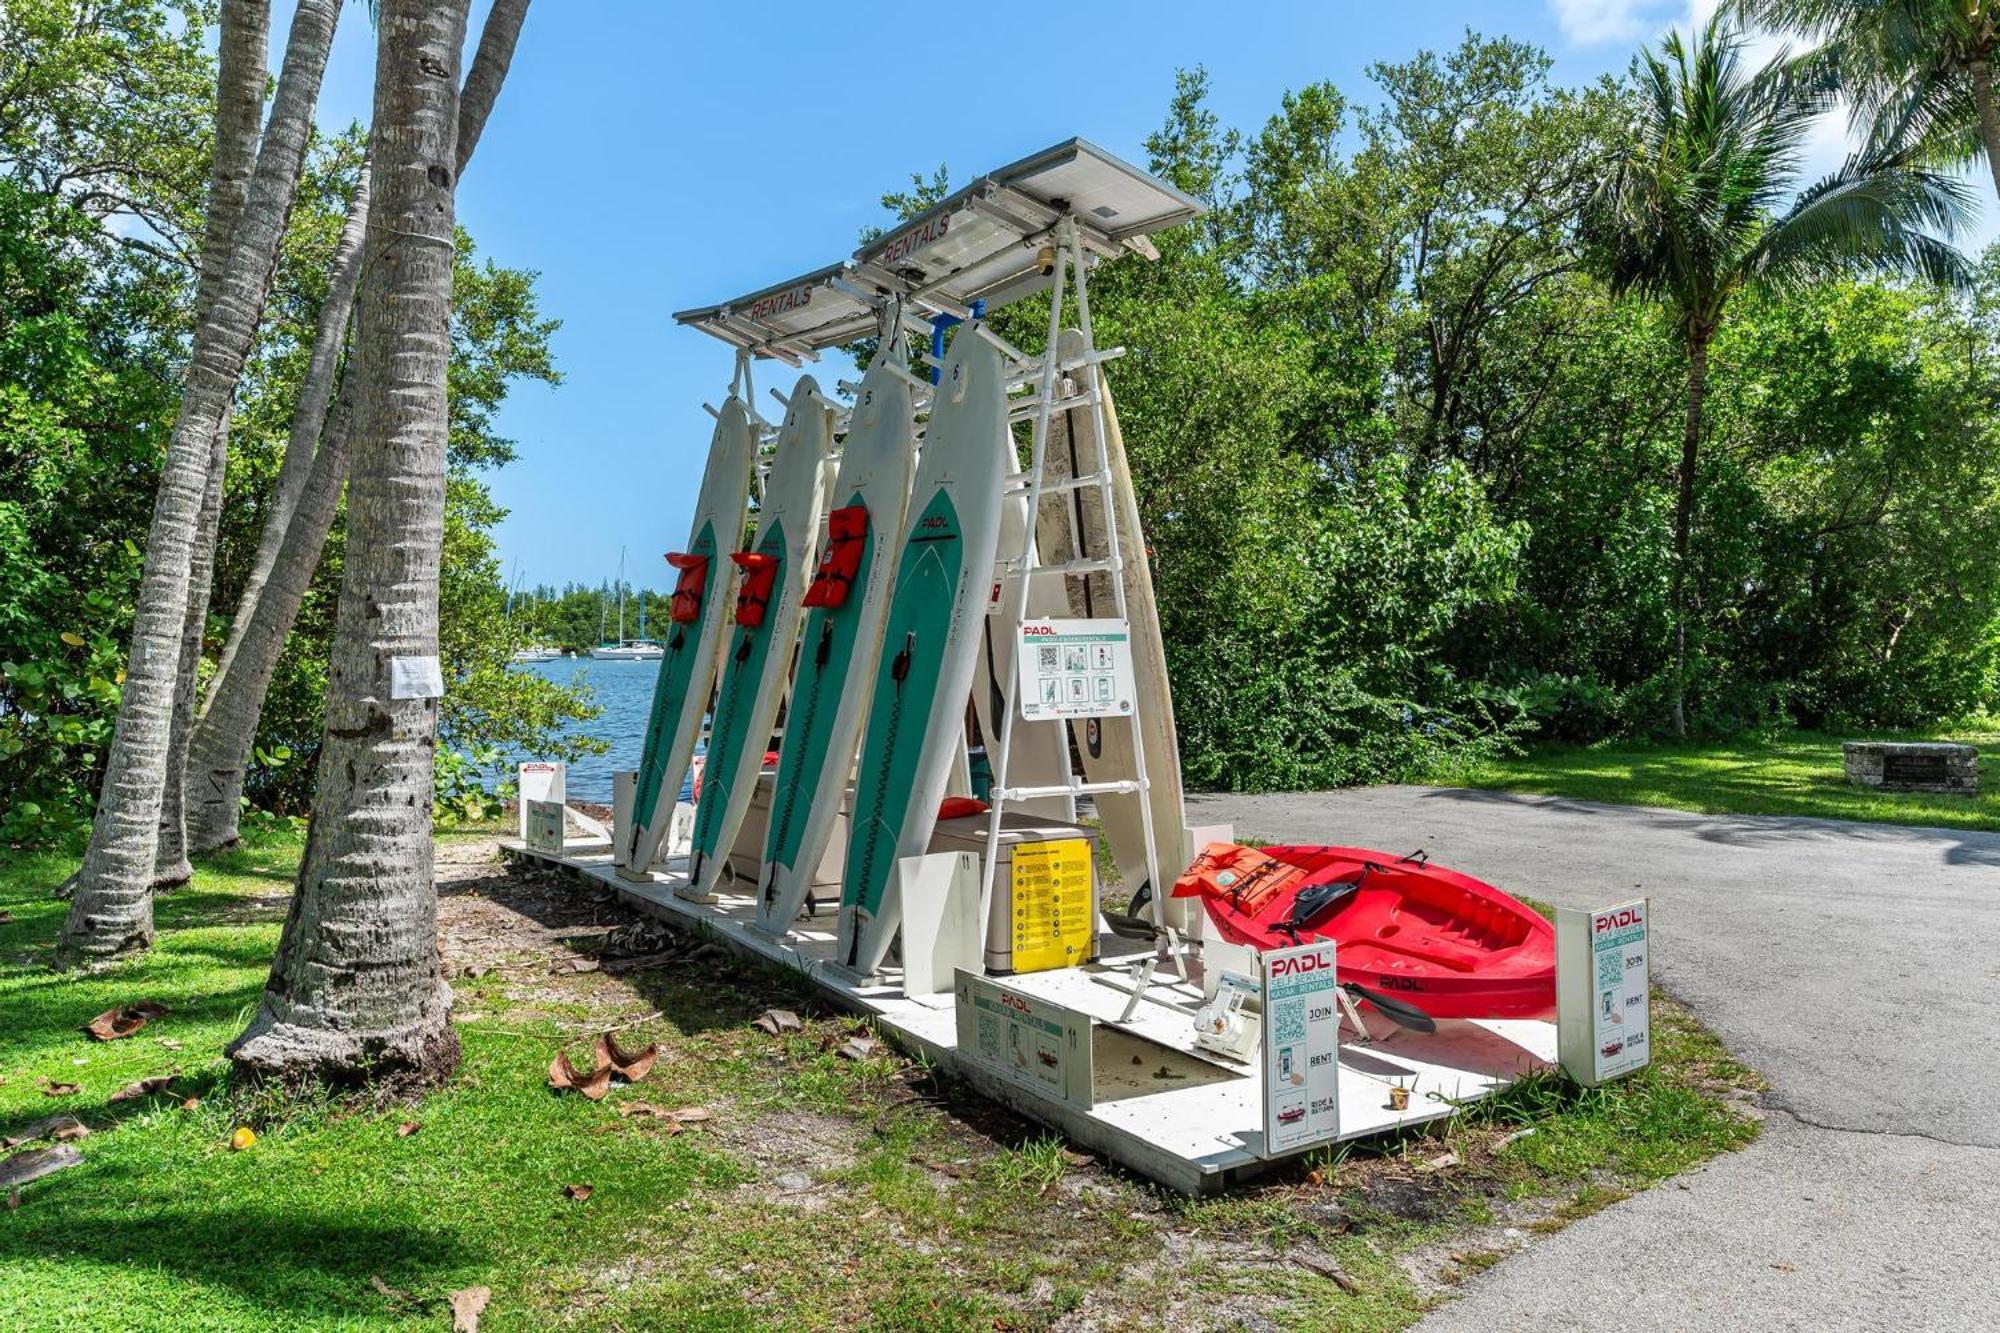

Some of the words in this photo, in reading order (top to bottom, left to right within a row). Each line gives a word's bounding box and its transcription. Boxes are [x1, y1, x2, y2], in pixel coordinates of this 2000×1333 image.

[884, 214, 950, 264] RENTALS
[751, 286, 812, 320] RENTALS
[953, 364, 959, 380] 6
[865, 390, 873, 405] 5
[1024, 626, 1057, 636] PADL
[1595, 909, 1642, 933] PADL
[1271, 953, 1331, 978] PADL
[1271, 976, 1293, 988] SELF
[1295, 969, 1332, 983] SERVICE
[1299, 980, 1333, 993] RENTALS
[1379, 975, 1424, 992] PADL
[1001, 994, 1032, 1013] PADL
[1626, 994, 1643, 1006] RENT
[1309, 1006, 1332, 1018] JOIN
[1310, 1053, 1332, 1066] RENT
